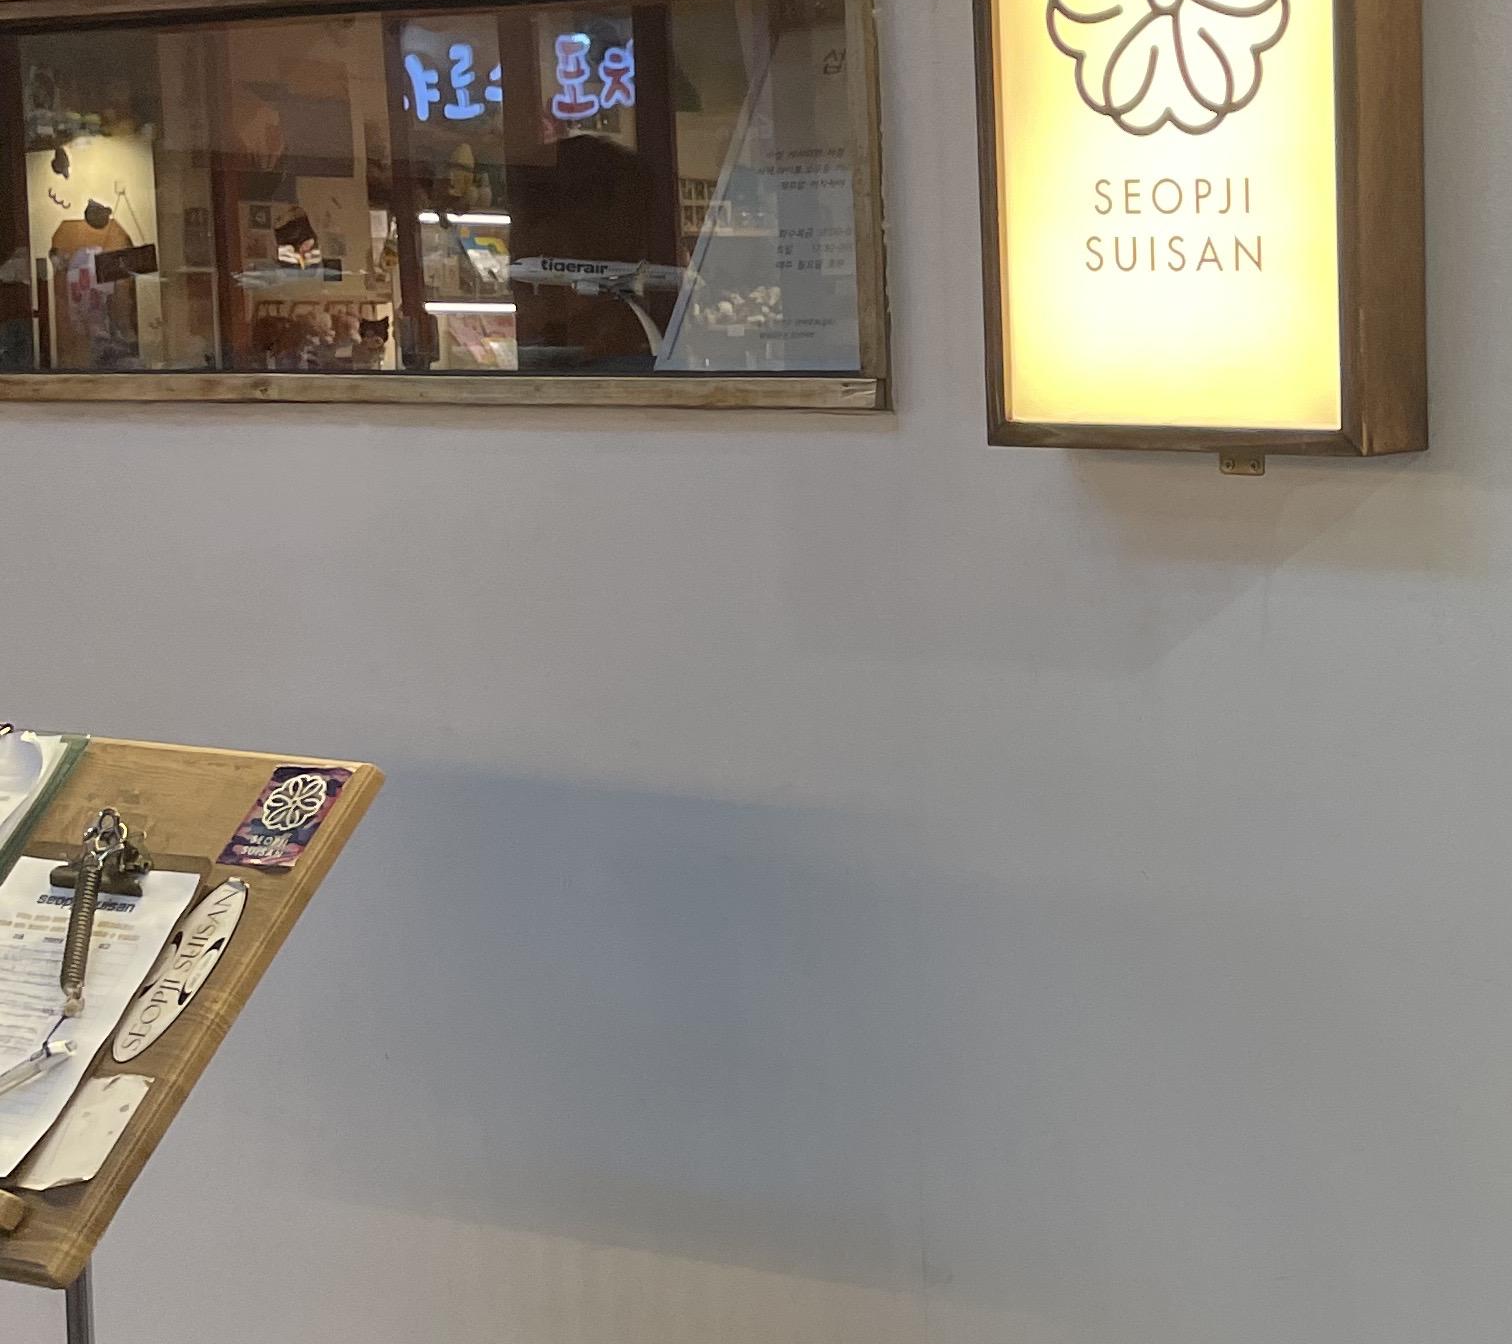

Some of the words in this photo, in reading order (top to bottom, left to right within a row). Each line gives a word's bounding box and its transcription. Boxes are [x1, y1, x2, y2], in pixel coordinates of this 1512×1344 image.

[1094, 177, 1251, 215] SEOPJI
[541, 257, 609, 275] tigerair
[1086, 235, 1262, 272] SUISAN
[121, 977, 182, 1052] SEOPJI
[174, 888, 241, 973] SUISAN
